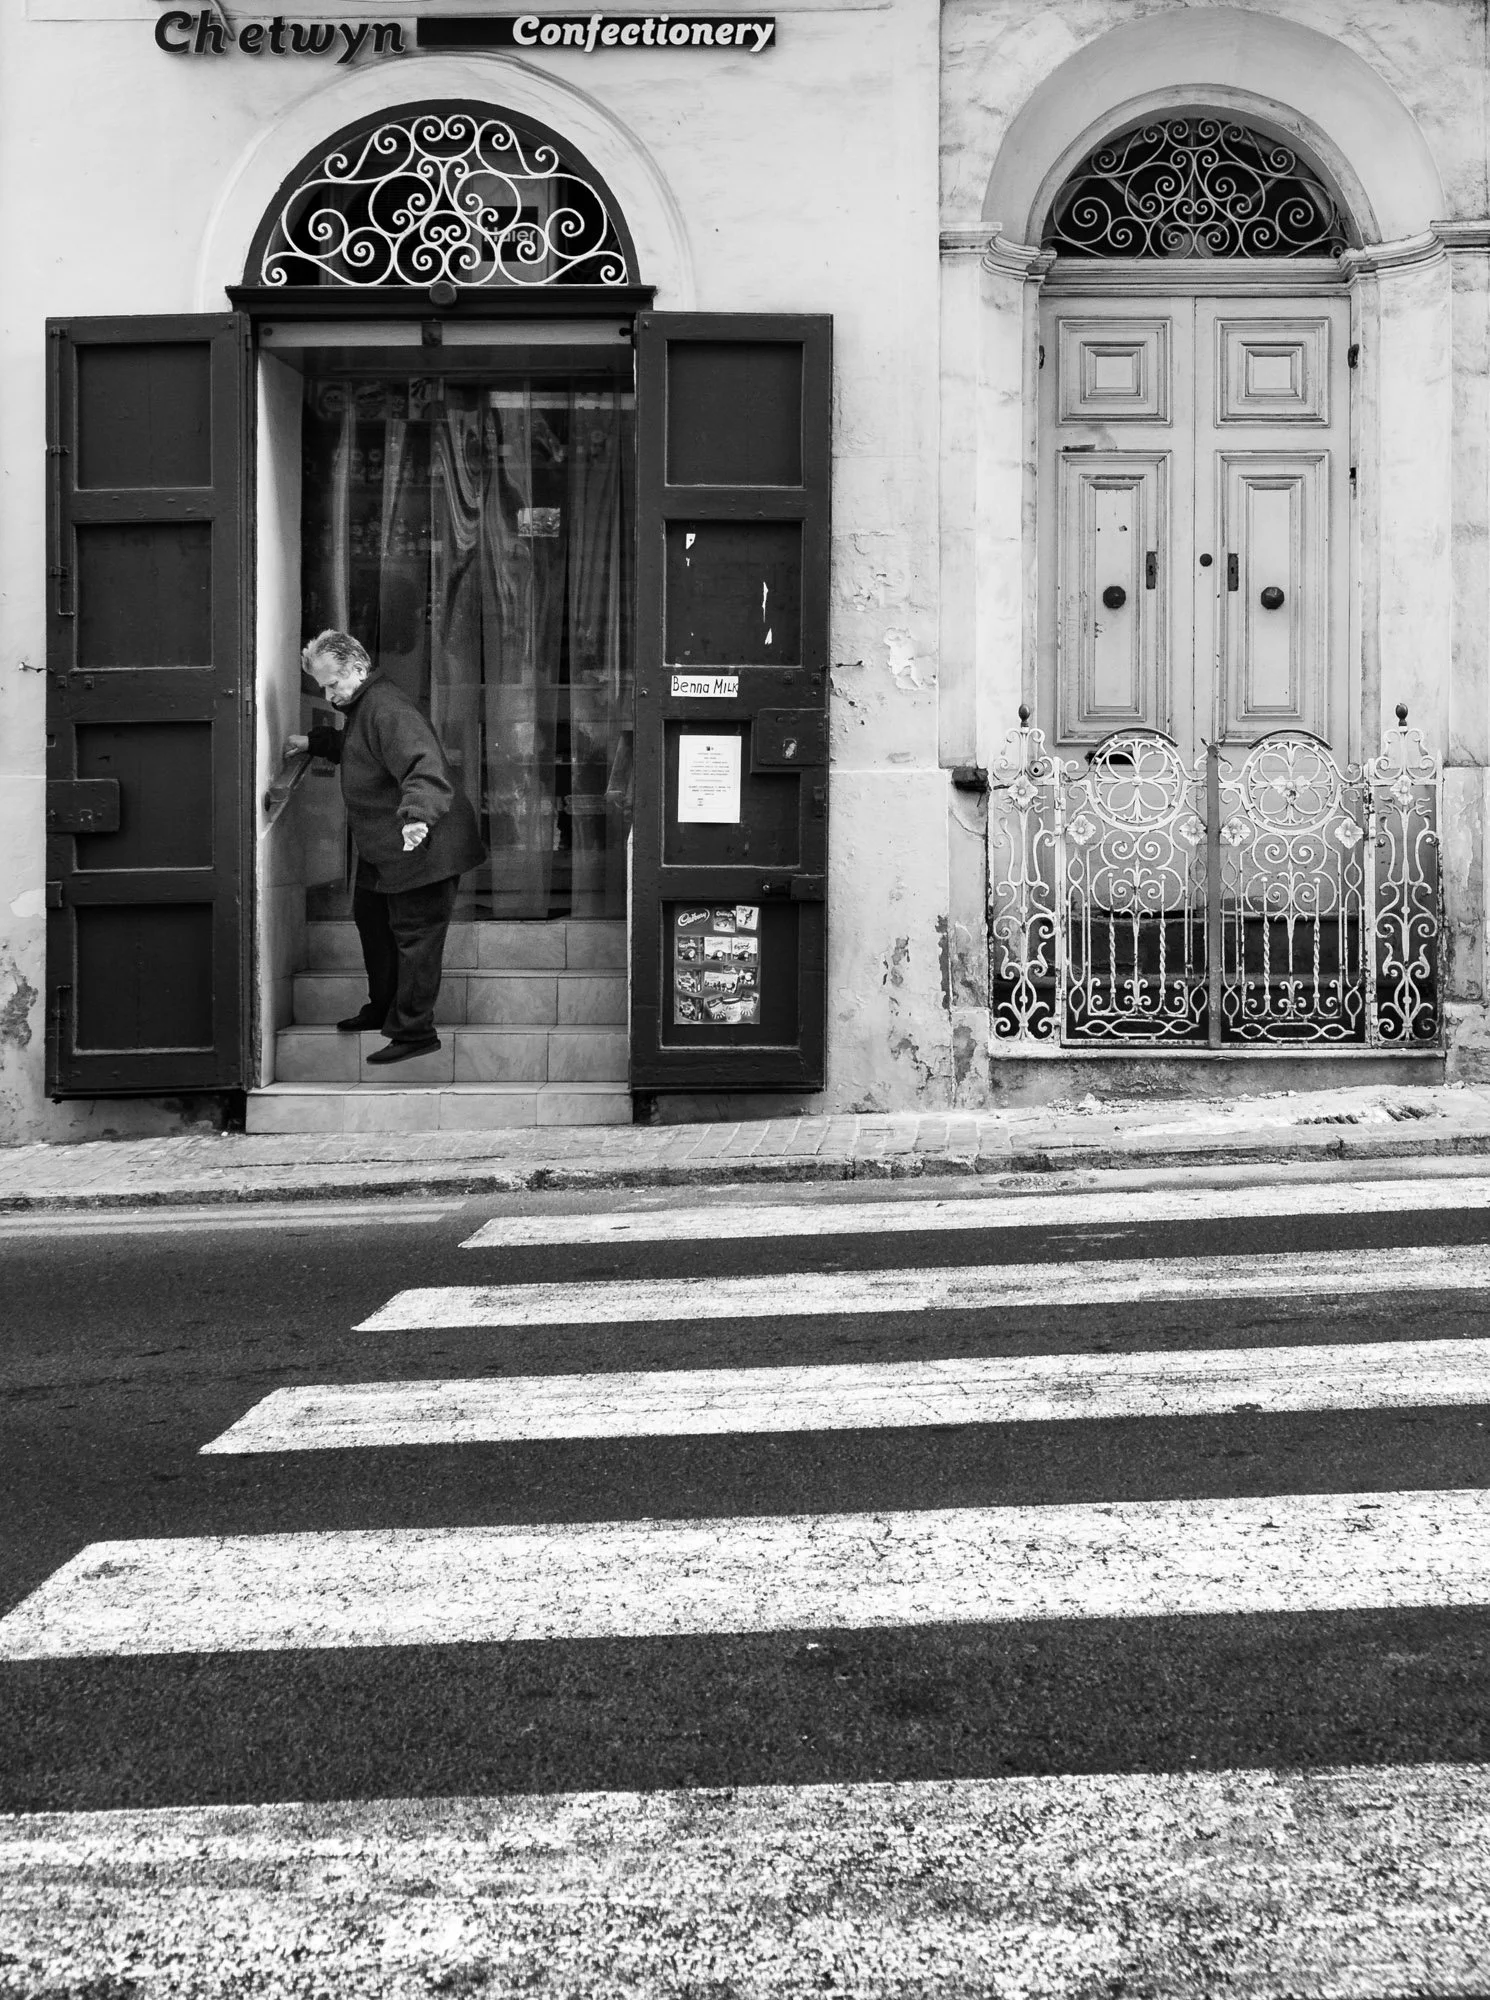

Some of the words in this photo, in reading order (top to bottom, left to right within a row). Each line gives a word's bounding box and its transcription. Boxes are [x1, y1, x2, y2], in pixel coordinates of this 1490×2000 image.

[154, 9, 405, 64] Chetwyn
[512, 14, 774, 52] Confectionery
[673, 676, 709, 694] Benna
[677, 909, 709, 926] Cadbury
